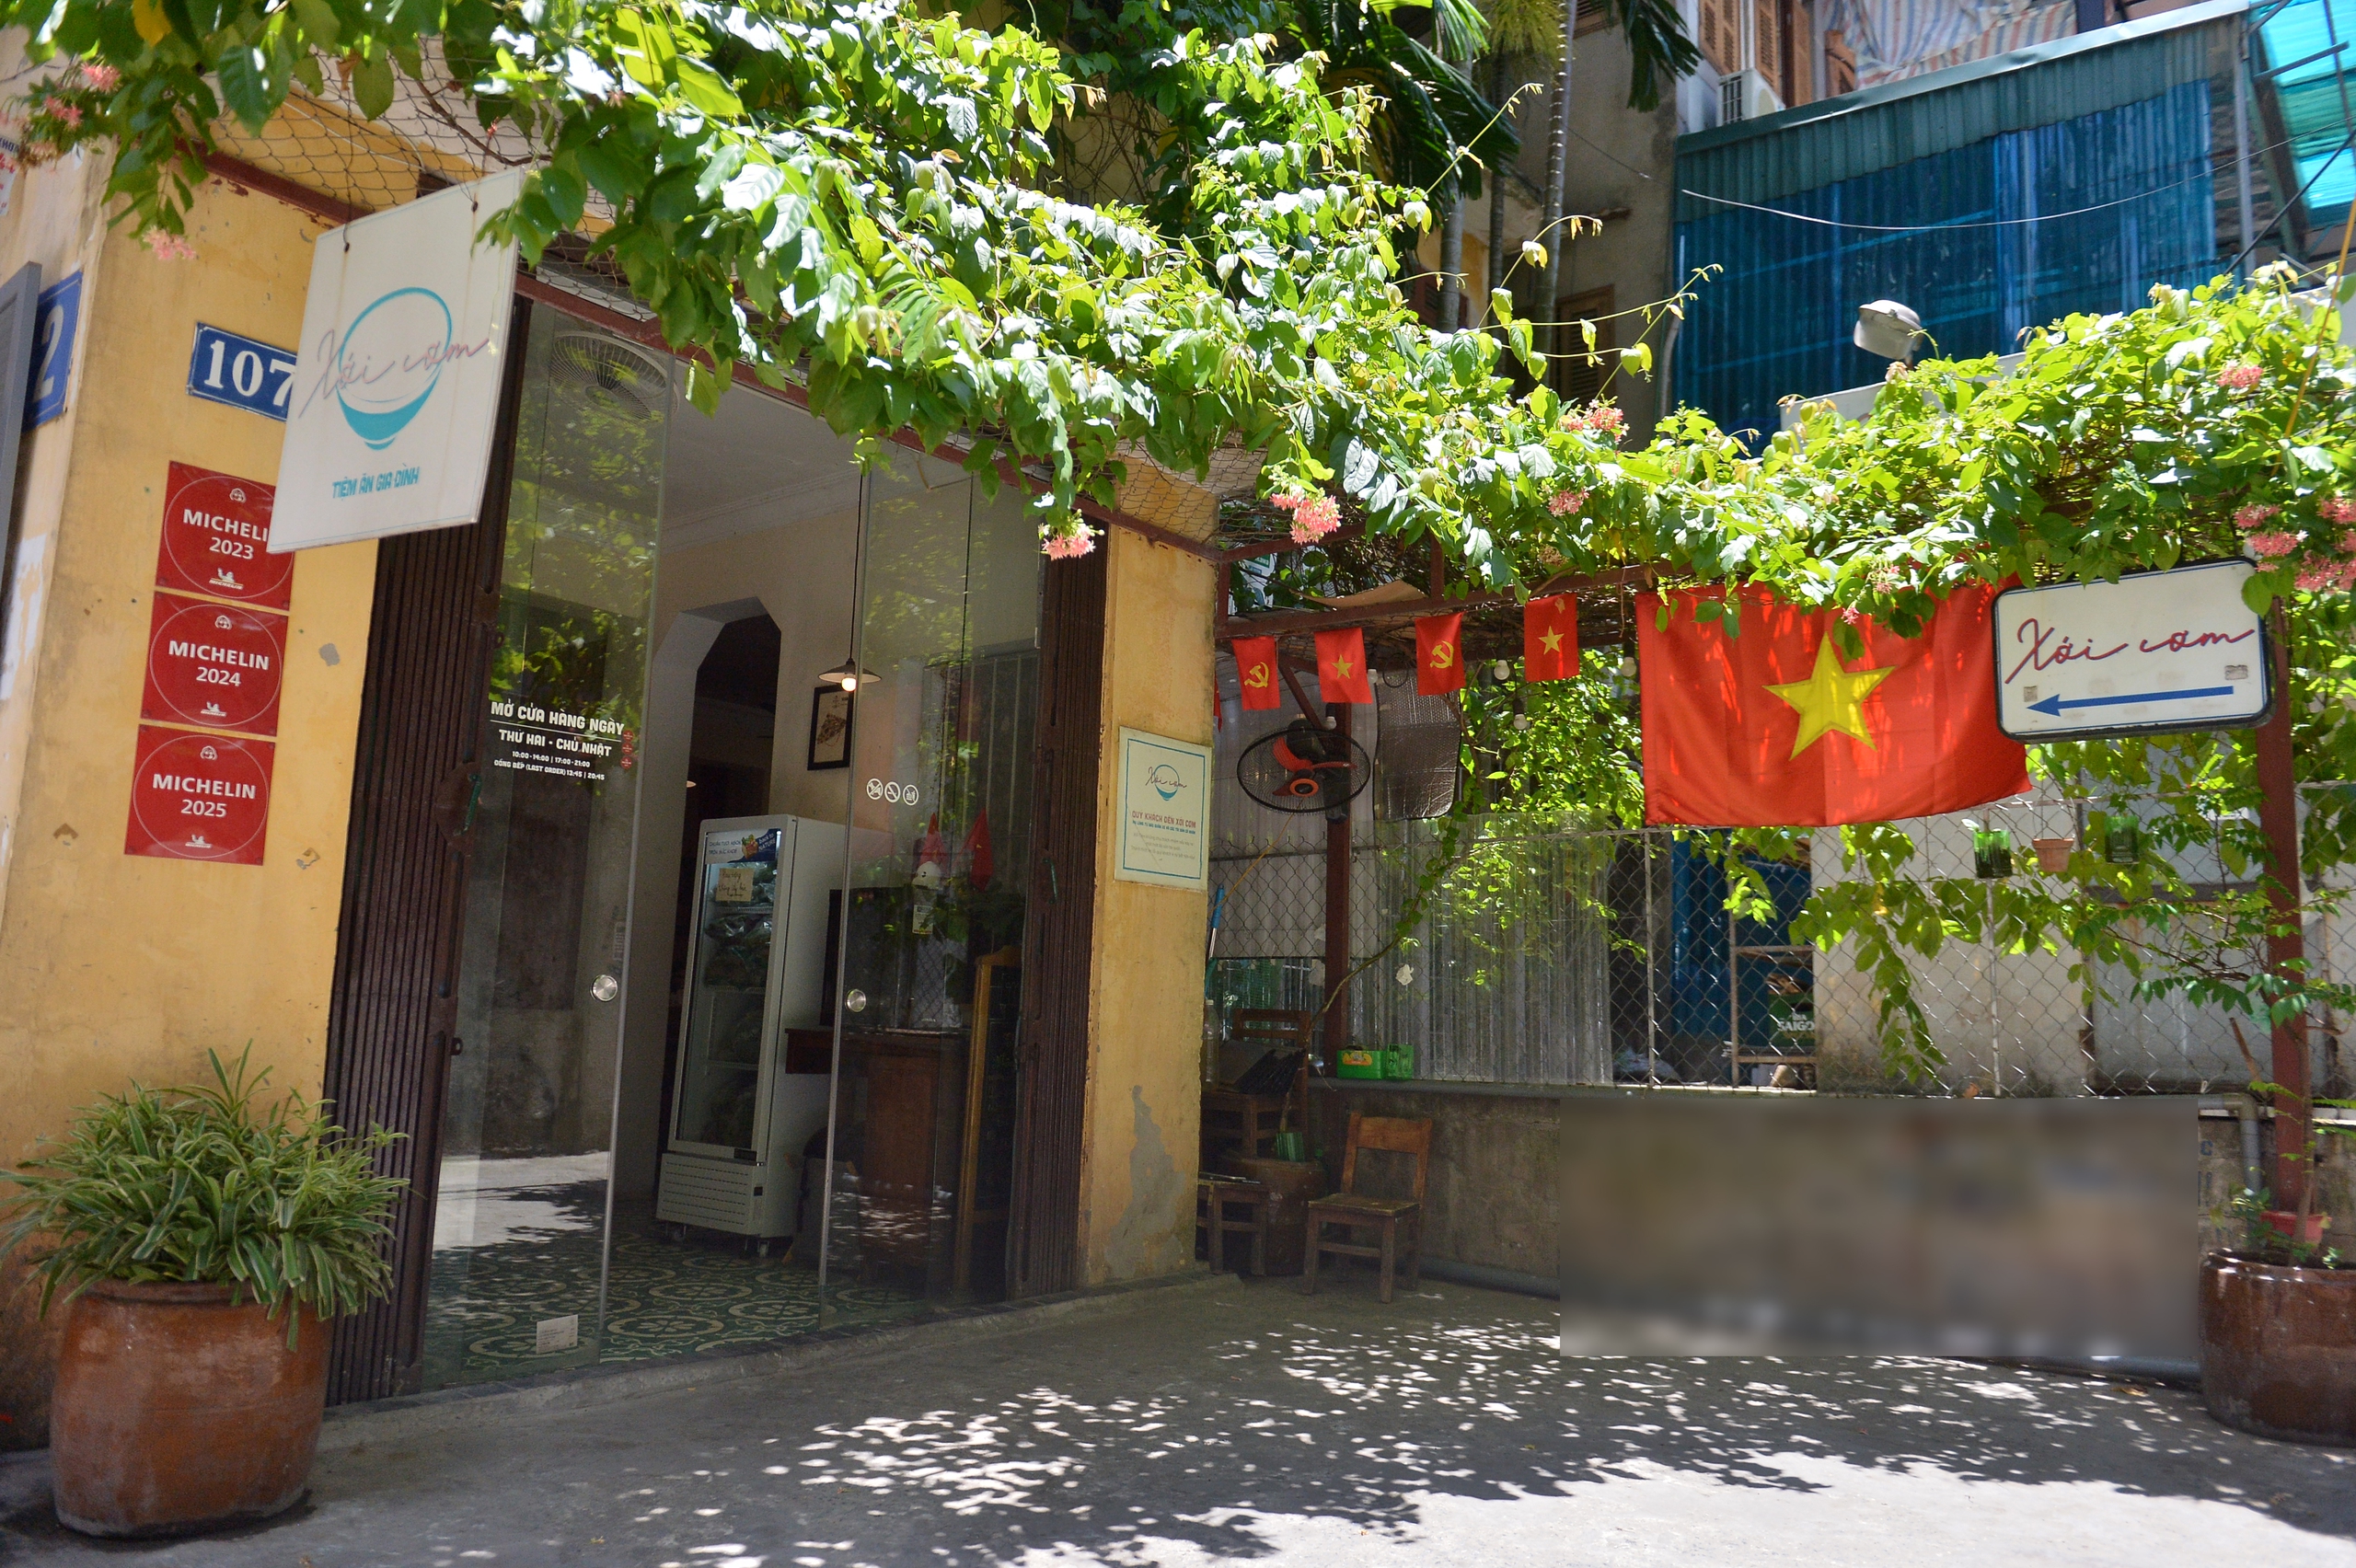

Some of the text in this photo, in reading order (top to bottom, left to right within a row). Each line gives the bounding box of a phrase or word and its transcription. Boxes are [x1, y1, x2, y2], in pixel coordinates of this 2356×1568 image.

[203, 340, 296, 407] 107
[298, 329, 490, 419] Xới cơm
[332, 463, 421, 501] TIỆM ĂN GIA ĐÌNH
[183, 509, 268, 542] MICHELI
[209, 536, 254, 559] 2023
[168, 640, 270, 671] MICHELIN
[2004, 617, 2255, 685] Xới cơm
[196, 666, 241, 687] 2024
[491, 698, 625, 735] MỞ CỬA HÀNG NGÀY
[499, 729, 525, 743] THỨ
[526, 733, 546, 746] HAI
[556, 736, 579, 752] CHỦ
[582, 743, 612, 758] NHẬT
[153, 773, 257, 800] MICHELIN
[587, 772, 605, 780] 20:45
[180, 799, 227, 818] 2025
[1777, 1020, 1815, 1032] SAIGO
